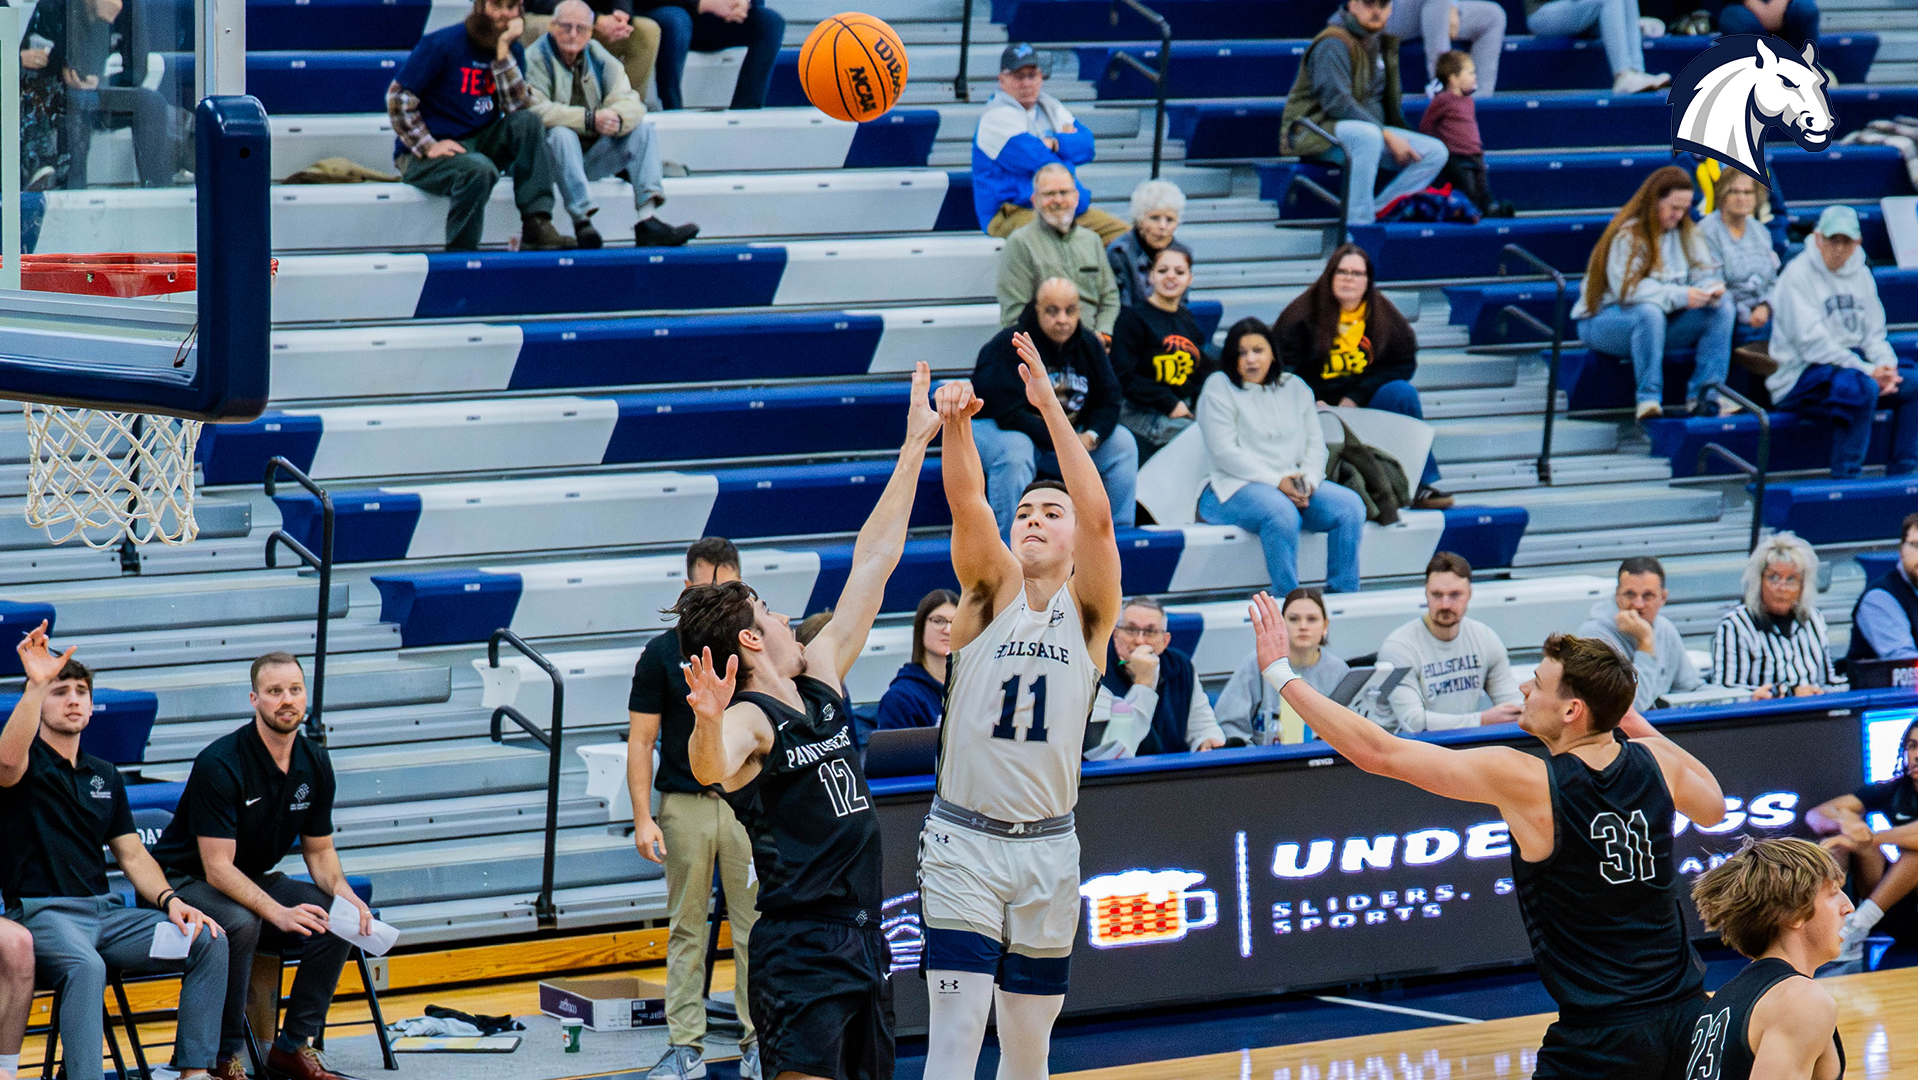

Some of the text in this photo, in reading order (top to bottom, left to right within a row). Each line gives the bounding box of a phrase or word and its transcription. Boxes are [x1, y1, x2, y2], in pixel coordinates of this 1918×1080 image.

[849, 66, 878, 113] NCAA
[990, 672, 1049, 743] 11
[818, 758, 869, 817] 12
[1590, 809, 1656, 885] 31
[1272, 902, 1442, 934] SPORTS
[1684, 1006, 1730, 1080] 23
